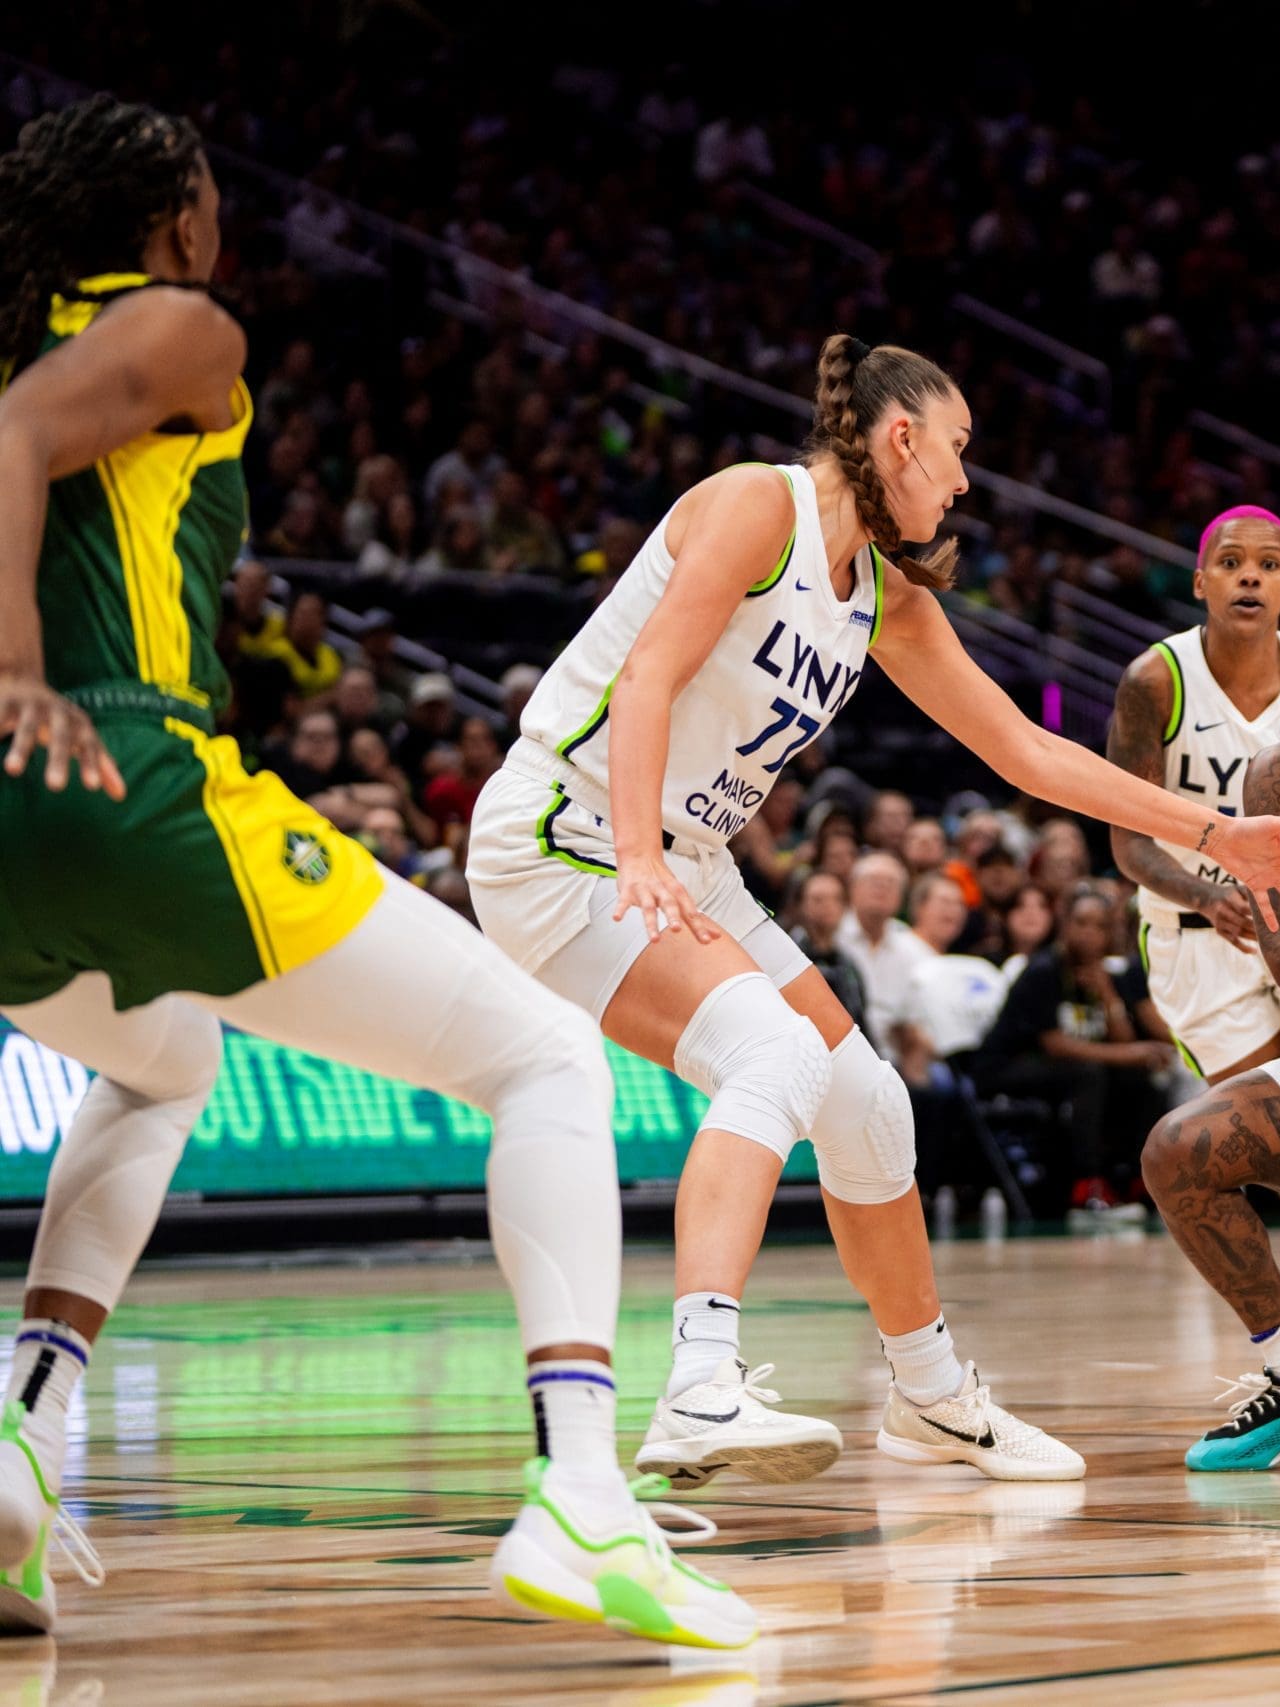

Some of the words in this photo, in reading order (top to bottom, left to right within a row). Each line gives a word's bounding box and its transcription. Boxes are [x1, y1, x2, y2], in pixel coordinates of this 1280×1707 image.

[752, 620, 862, 713] LYNX
[735, 697, 821, 773] 77
[711, 769, 763, 808] MAYO
[1179, 754, 1251, 796] LY
[1198, 863, 1239, 885] MA
